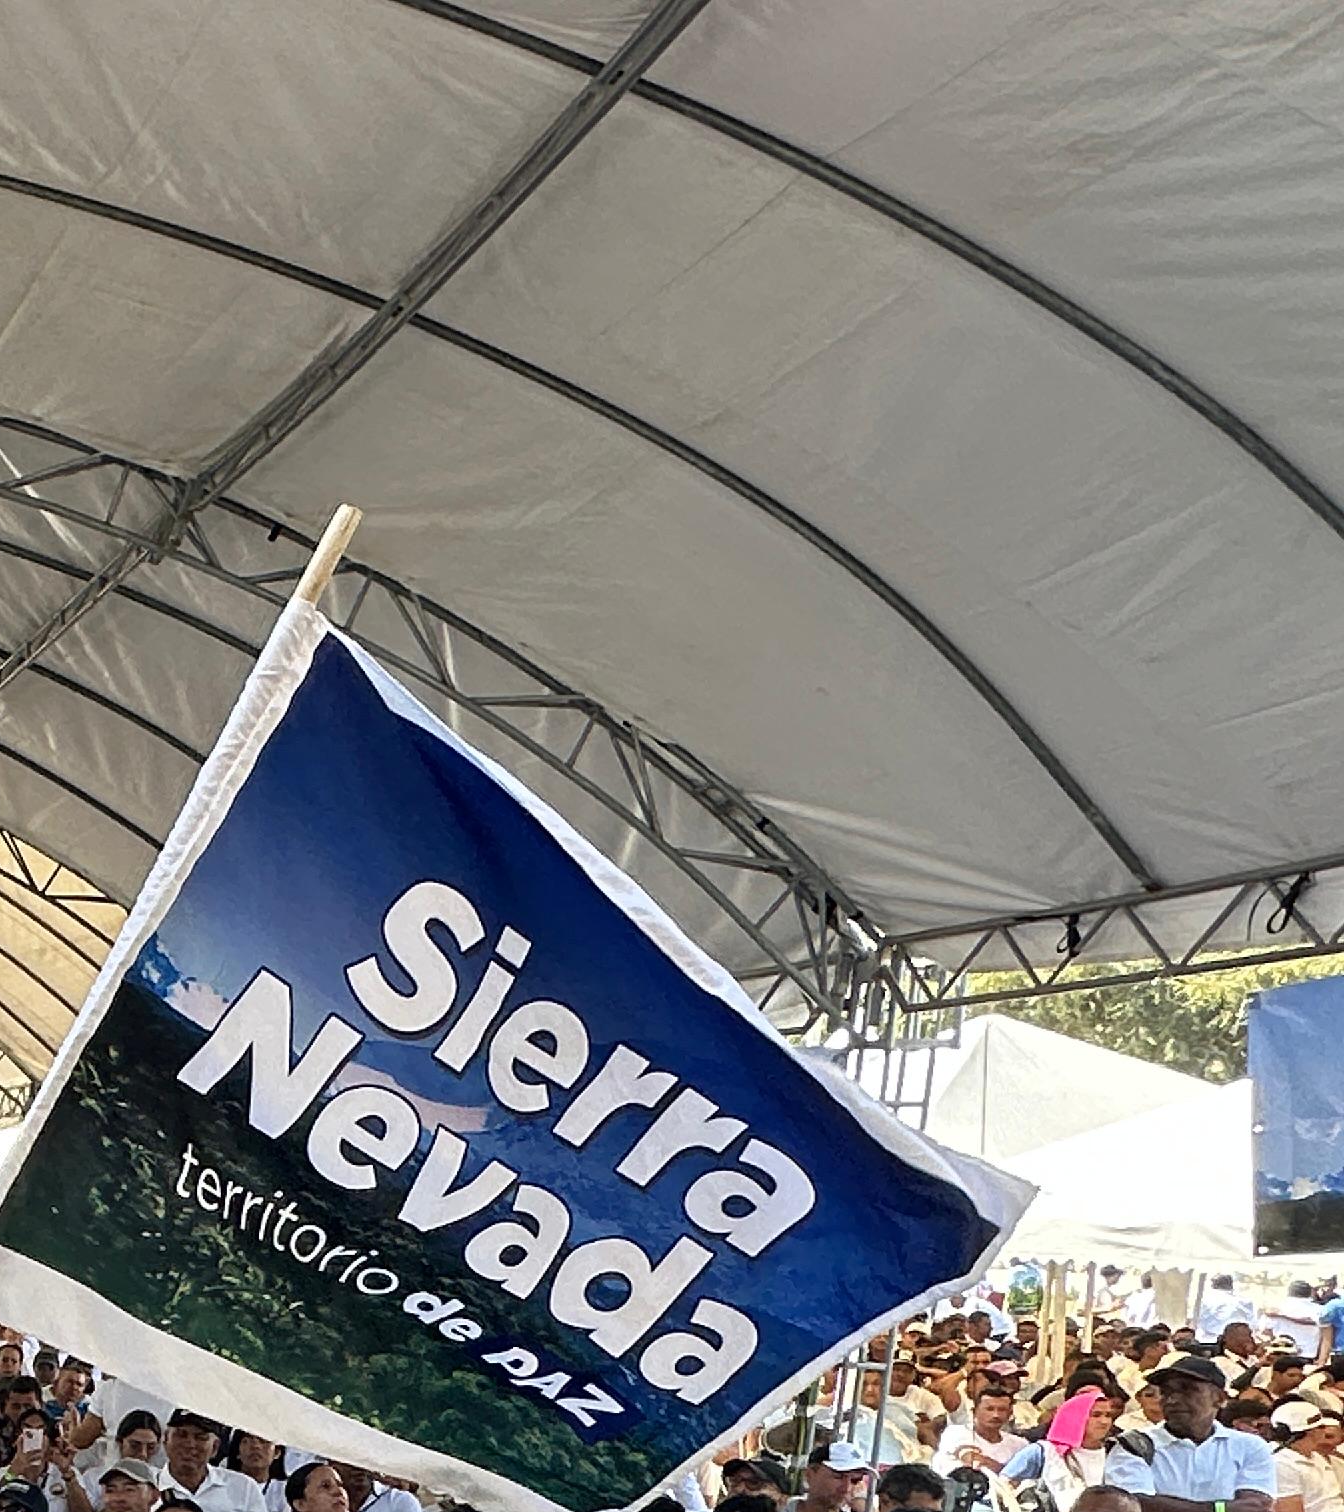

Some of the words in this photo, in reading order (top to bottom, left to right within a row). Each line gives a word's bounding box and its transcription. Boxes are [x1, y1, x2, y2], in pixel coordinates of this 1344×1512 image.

[174, 1142, 400, 1296] territorio
[403, 1290, 483, 1343] de
[176, 966, 759, 1407] Nevada
[346, 880, 816, 1258] Sierra
